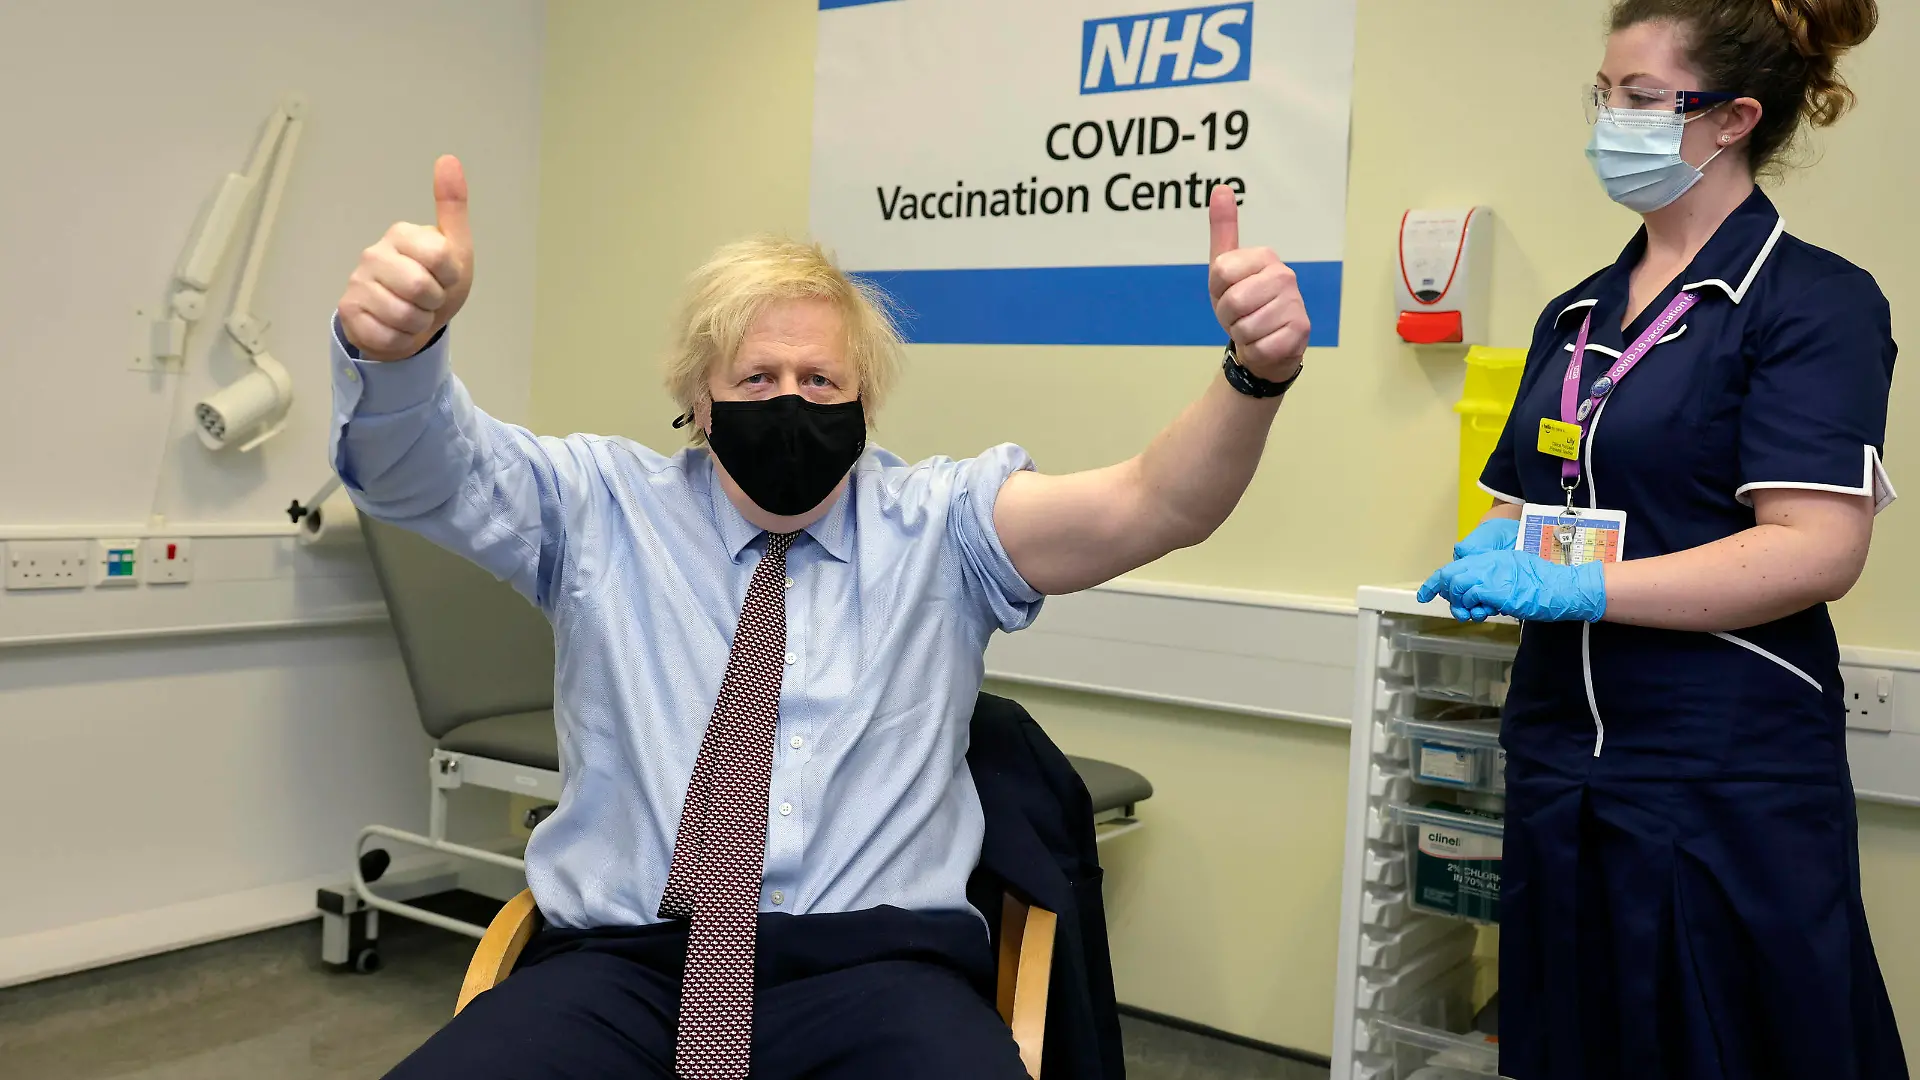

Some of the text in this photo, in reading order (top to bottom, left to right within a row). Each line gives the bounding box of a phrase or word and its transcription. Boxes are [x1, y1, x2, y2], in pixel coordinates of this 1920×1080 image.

[1083, 9, 1247, 89] NHS
[1046, 109, 1249, 160] COVID-19
[877, 172, 1246, 220] Vaccination Centre
[1612, 342, 1646, 377] COVID-19
[1645, 300, 1687, 343] vaccination
[1448, 863, 1460, 873] 2%
[1453, 873, 1463, 883] IN
[1486, 882, 1501, 892] AL
